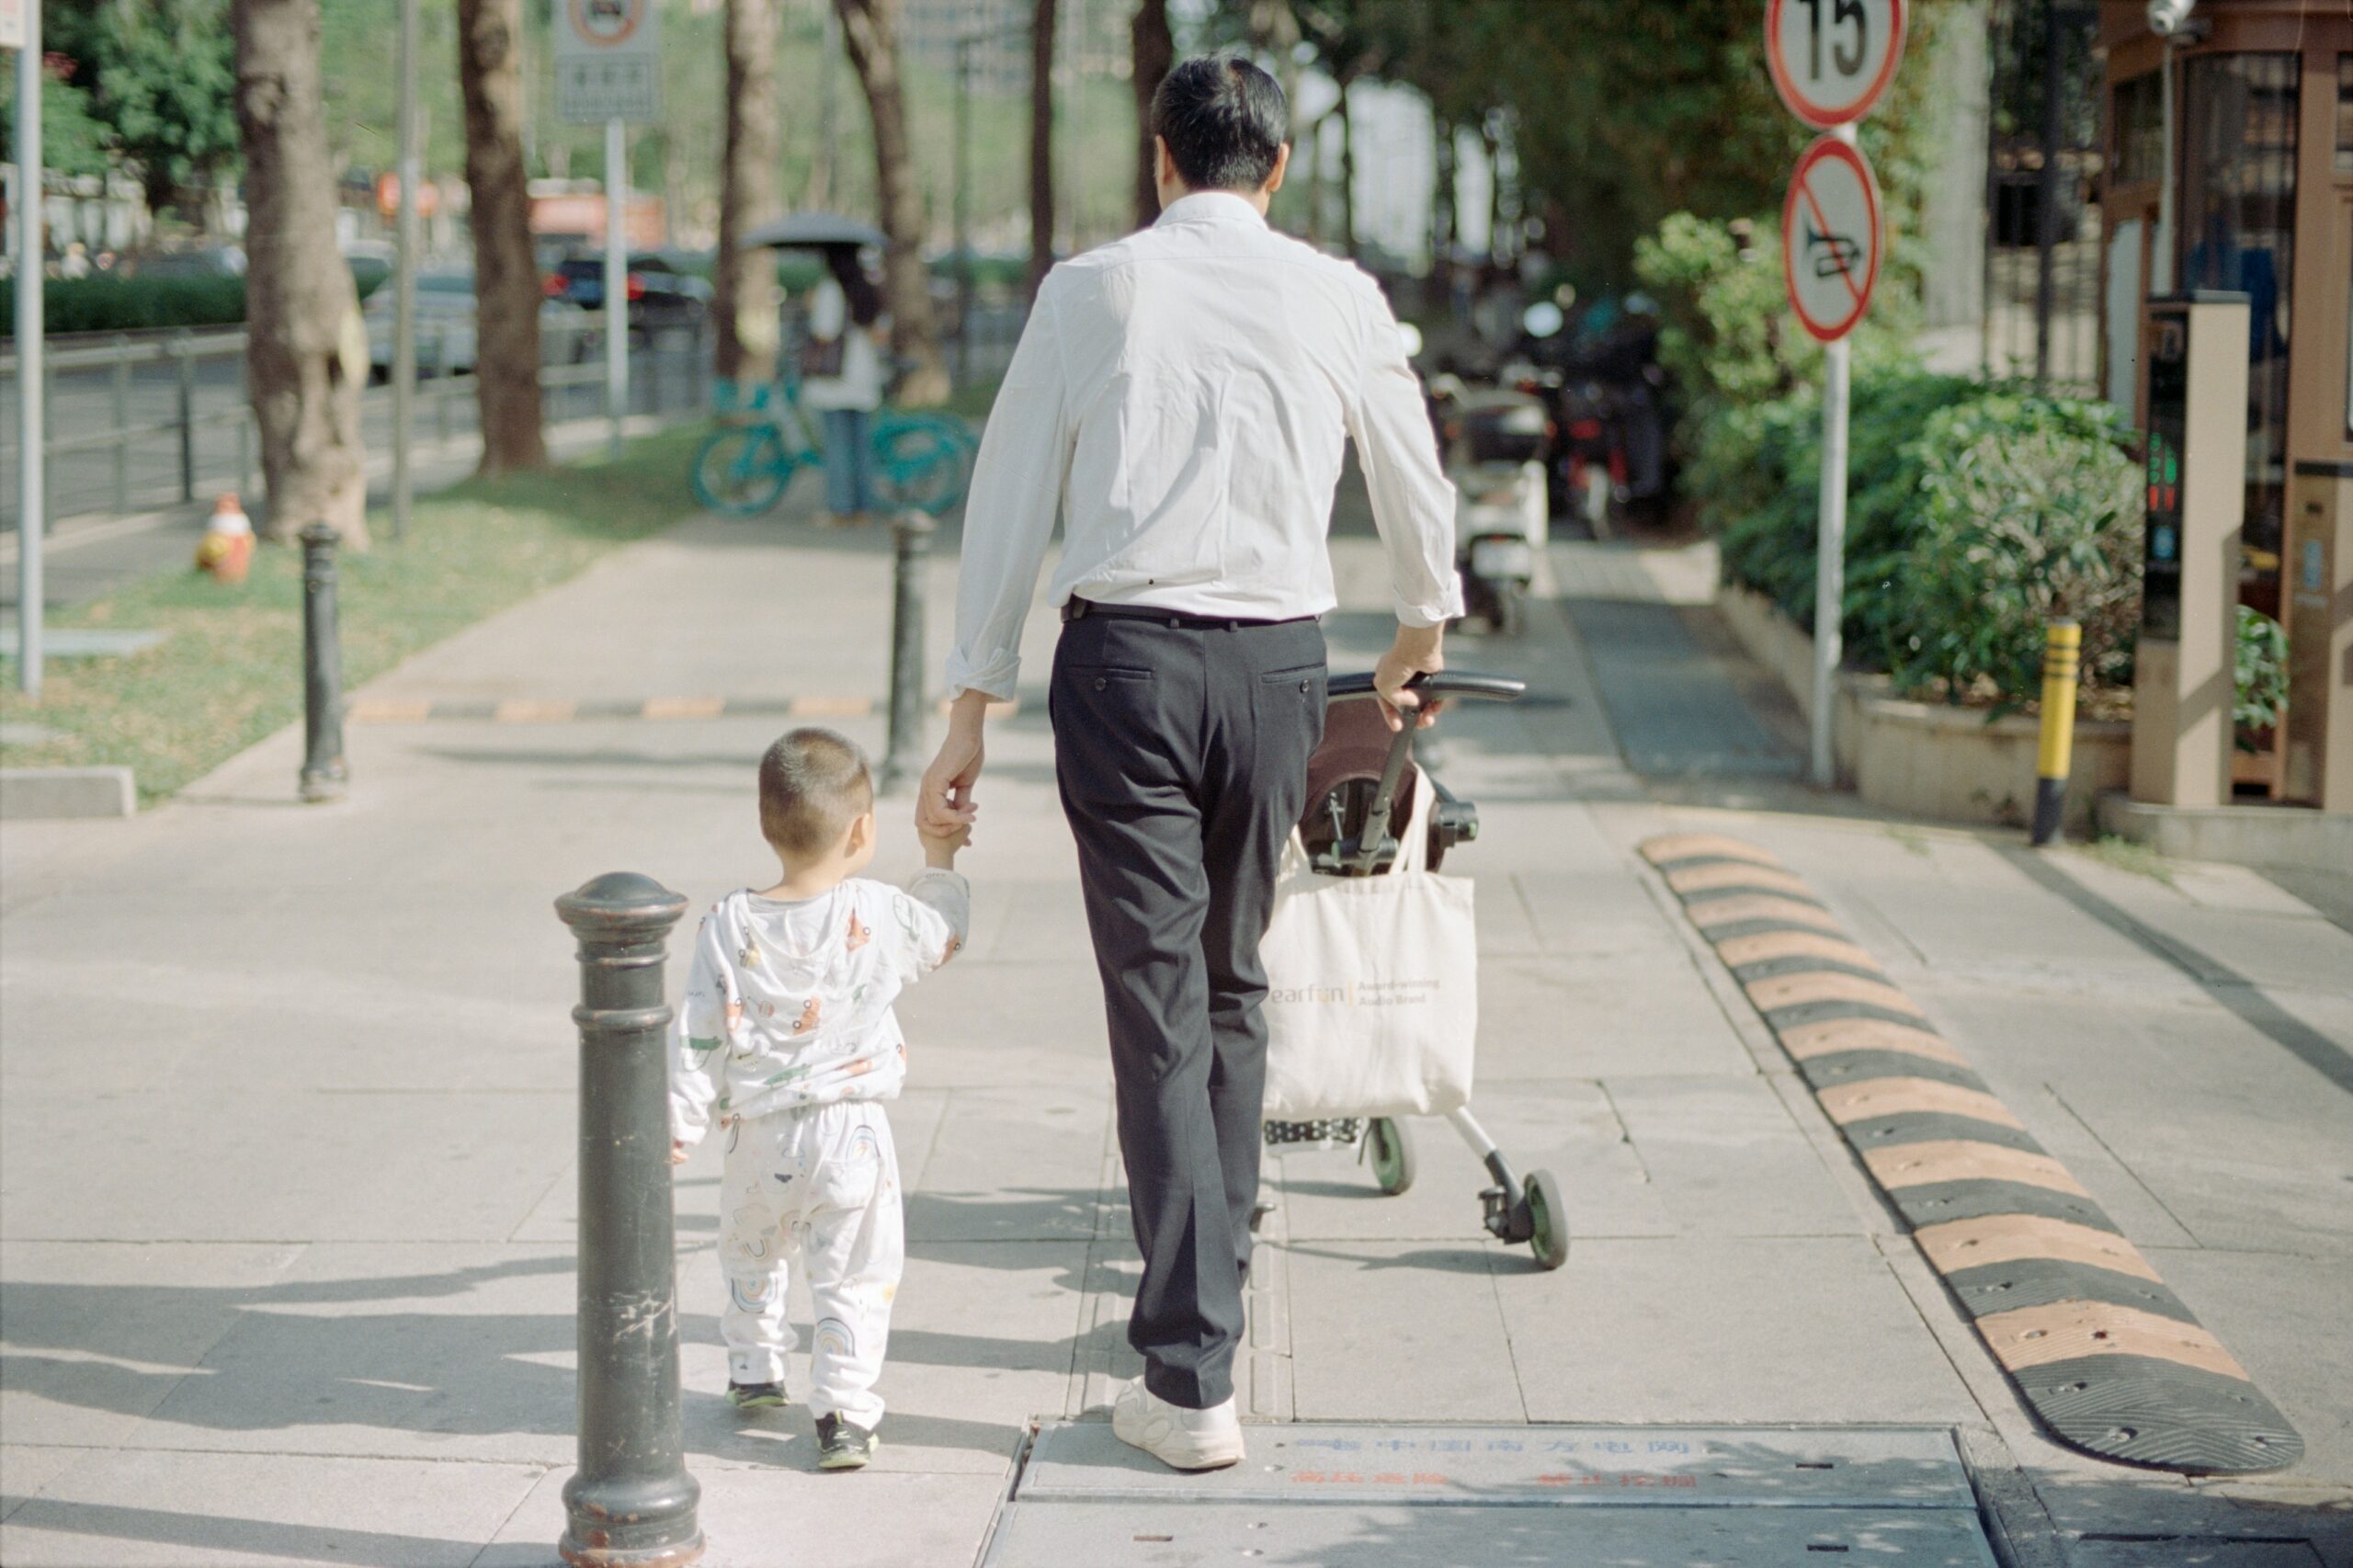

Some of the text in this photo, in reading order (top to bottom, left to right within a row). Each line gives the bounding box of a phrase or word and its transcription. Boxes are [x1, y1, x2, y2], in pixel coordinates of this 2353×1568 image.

[1797, 0, 1868, 80] 15
[1358, 994, 1427, 1007] Audio Brand
